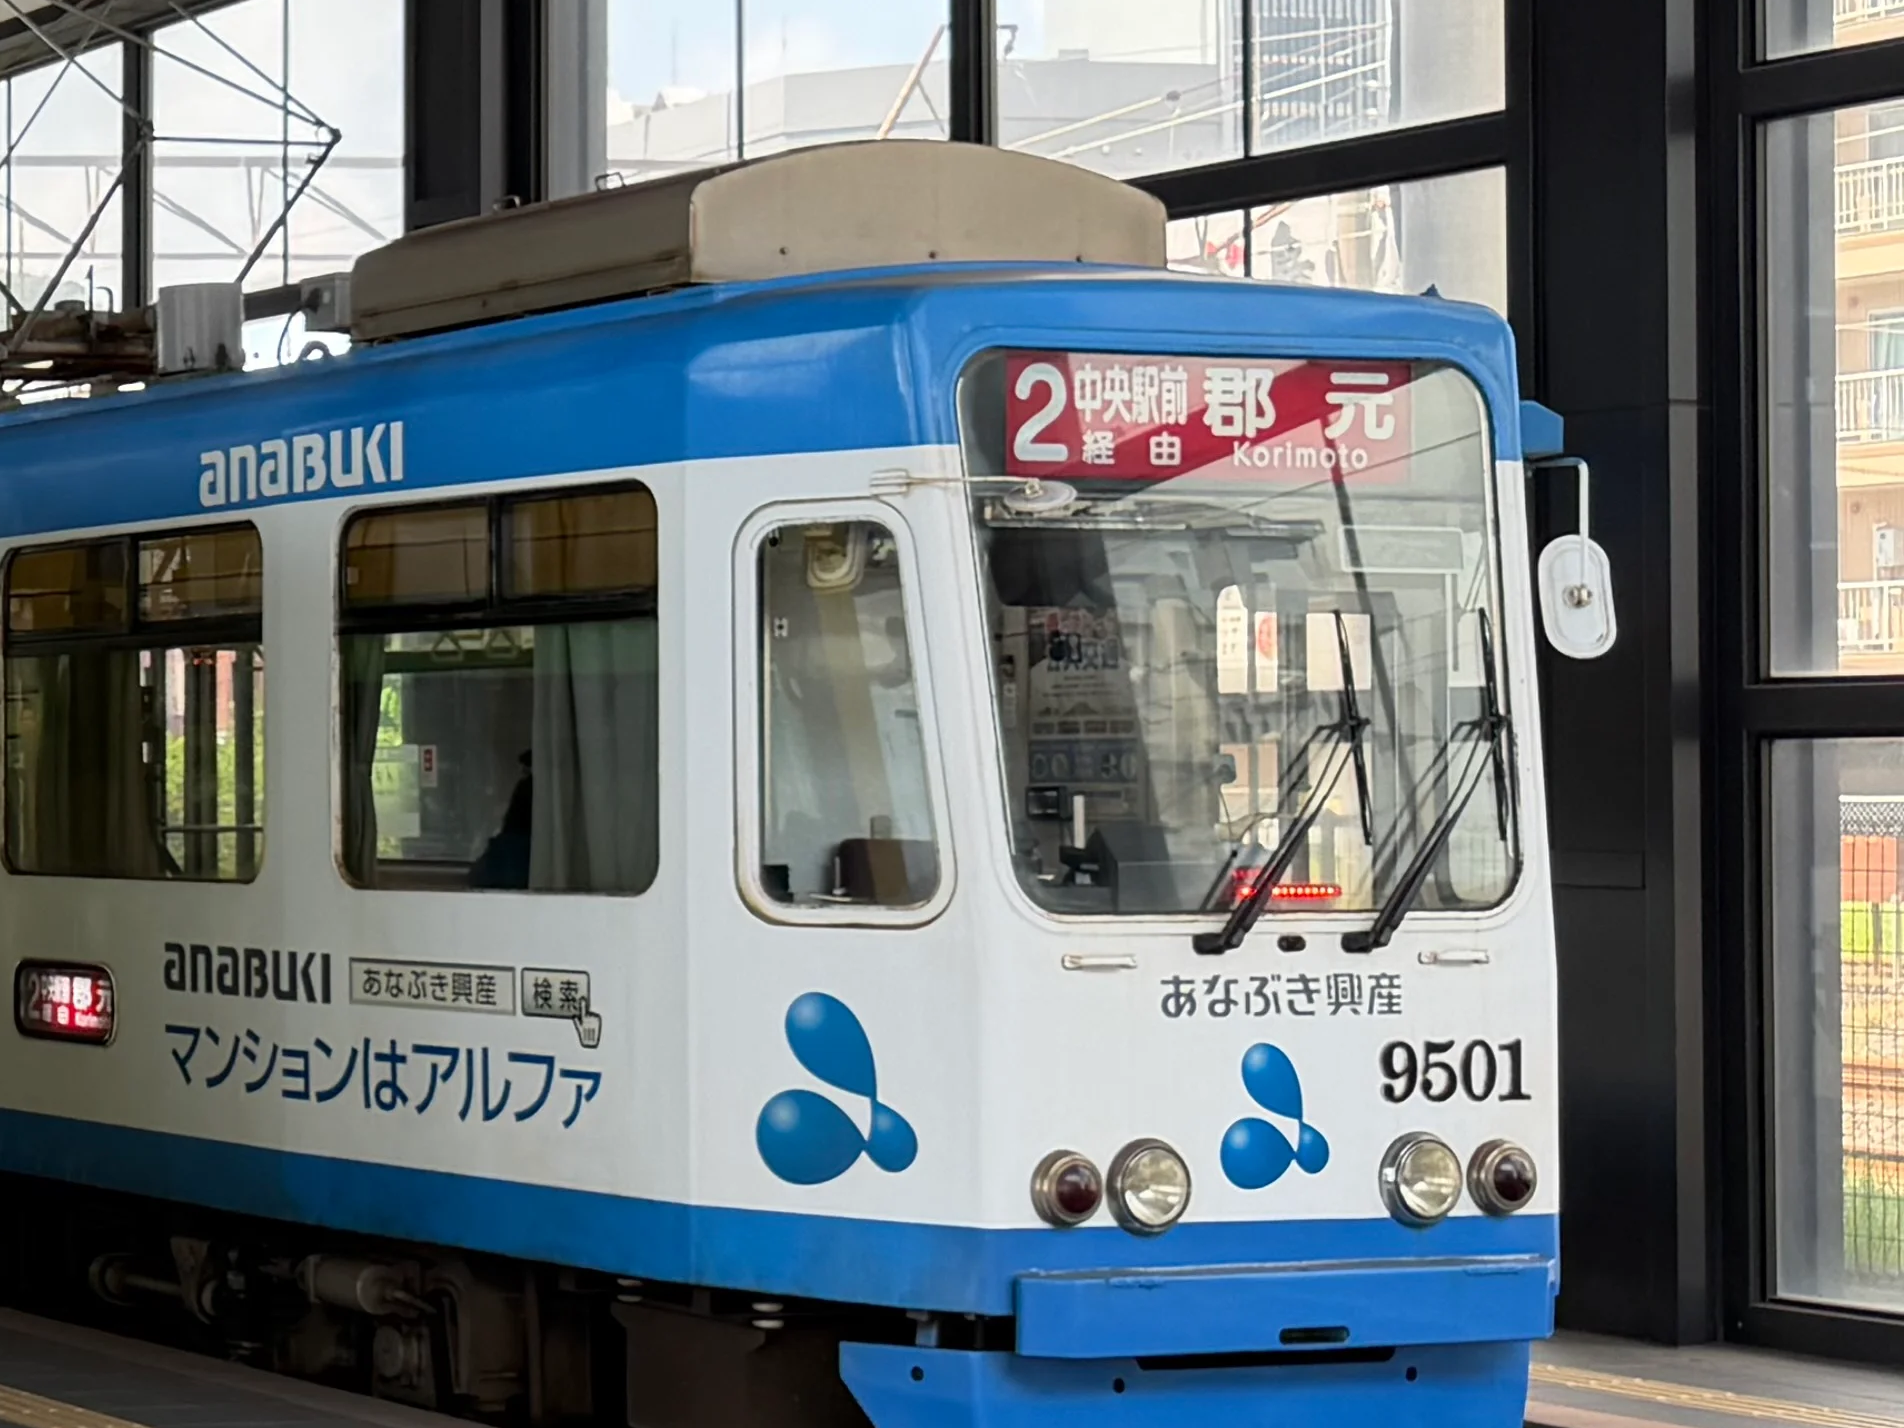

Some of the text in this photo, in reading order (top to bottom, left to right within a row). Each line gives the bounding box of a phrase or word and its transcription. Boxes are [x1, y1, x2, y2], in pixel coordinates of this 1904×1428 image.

[1013, 362, 1069, 462] 2
[1074, 363, 1189, 426] 中央駅前
[1202, 367, 1396, 440] 郡元
[1082, 429, 1182, 466] 経由
[1233, 441, 1369, 469] Korimoto
[360, 968, 498, 1007] あなぶき興産
[532, 976, 580, 1012] 検索
[1159, 973, 1403, 1019] あなぶき興産
[164, 1023, 603, 1130] マンションはアルファ
[1379, 1037, 1533, 1104] 9501
